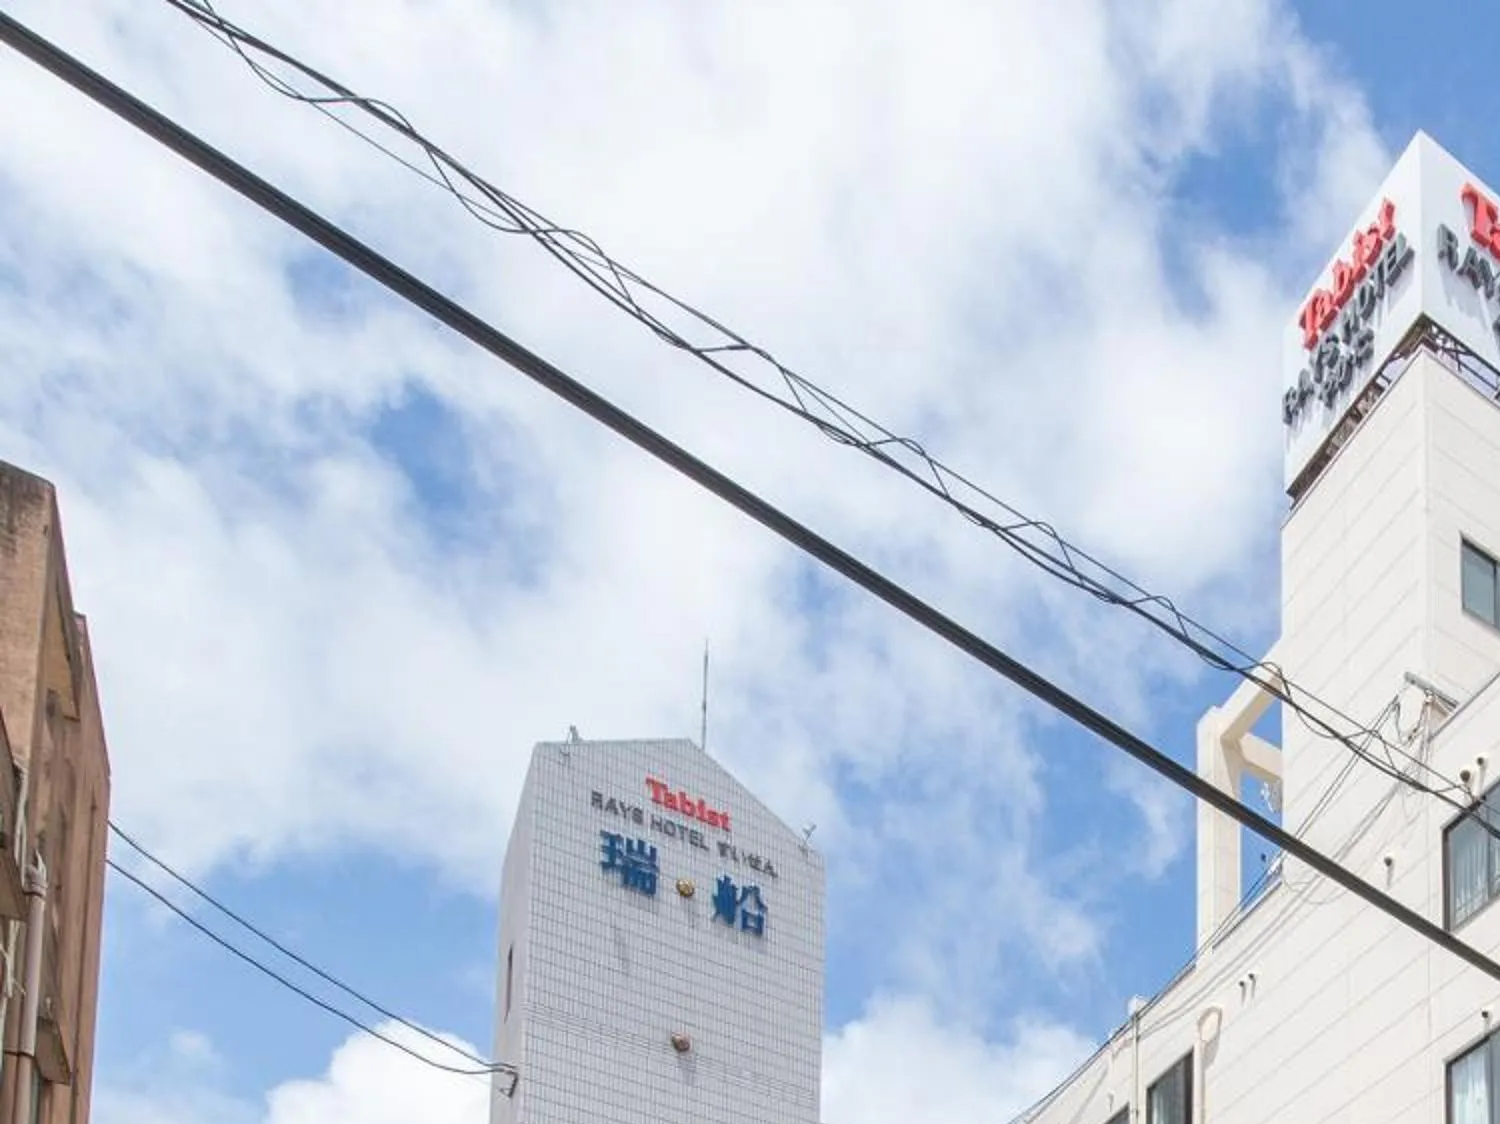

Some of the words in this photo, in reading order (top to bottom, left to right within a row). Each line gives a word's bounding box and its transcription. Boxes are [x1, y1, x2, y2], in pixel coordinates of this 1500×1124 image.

[1298, 198, 1395, 351] Tabist
[1341, 232, 1415, 346] HOTEL
[590, 790, 644, 825] RAYS
[649, 814, 710, 852] HOTEL
[645, 776, 732, 832] Tabist
